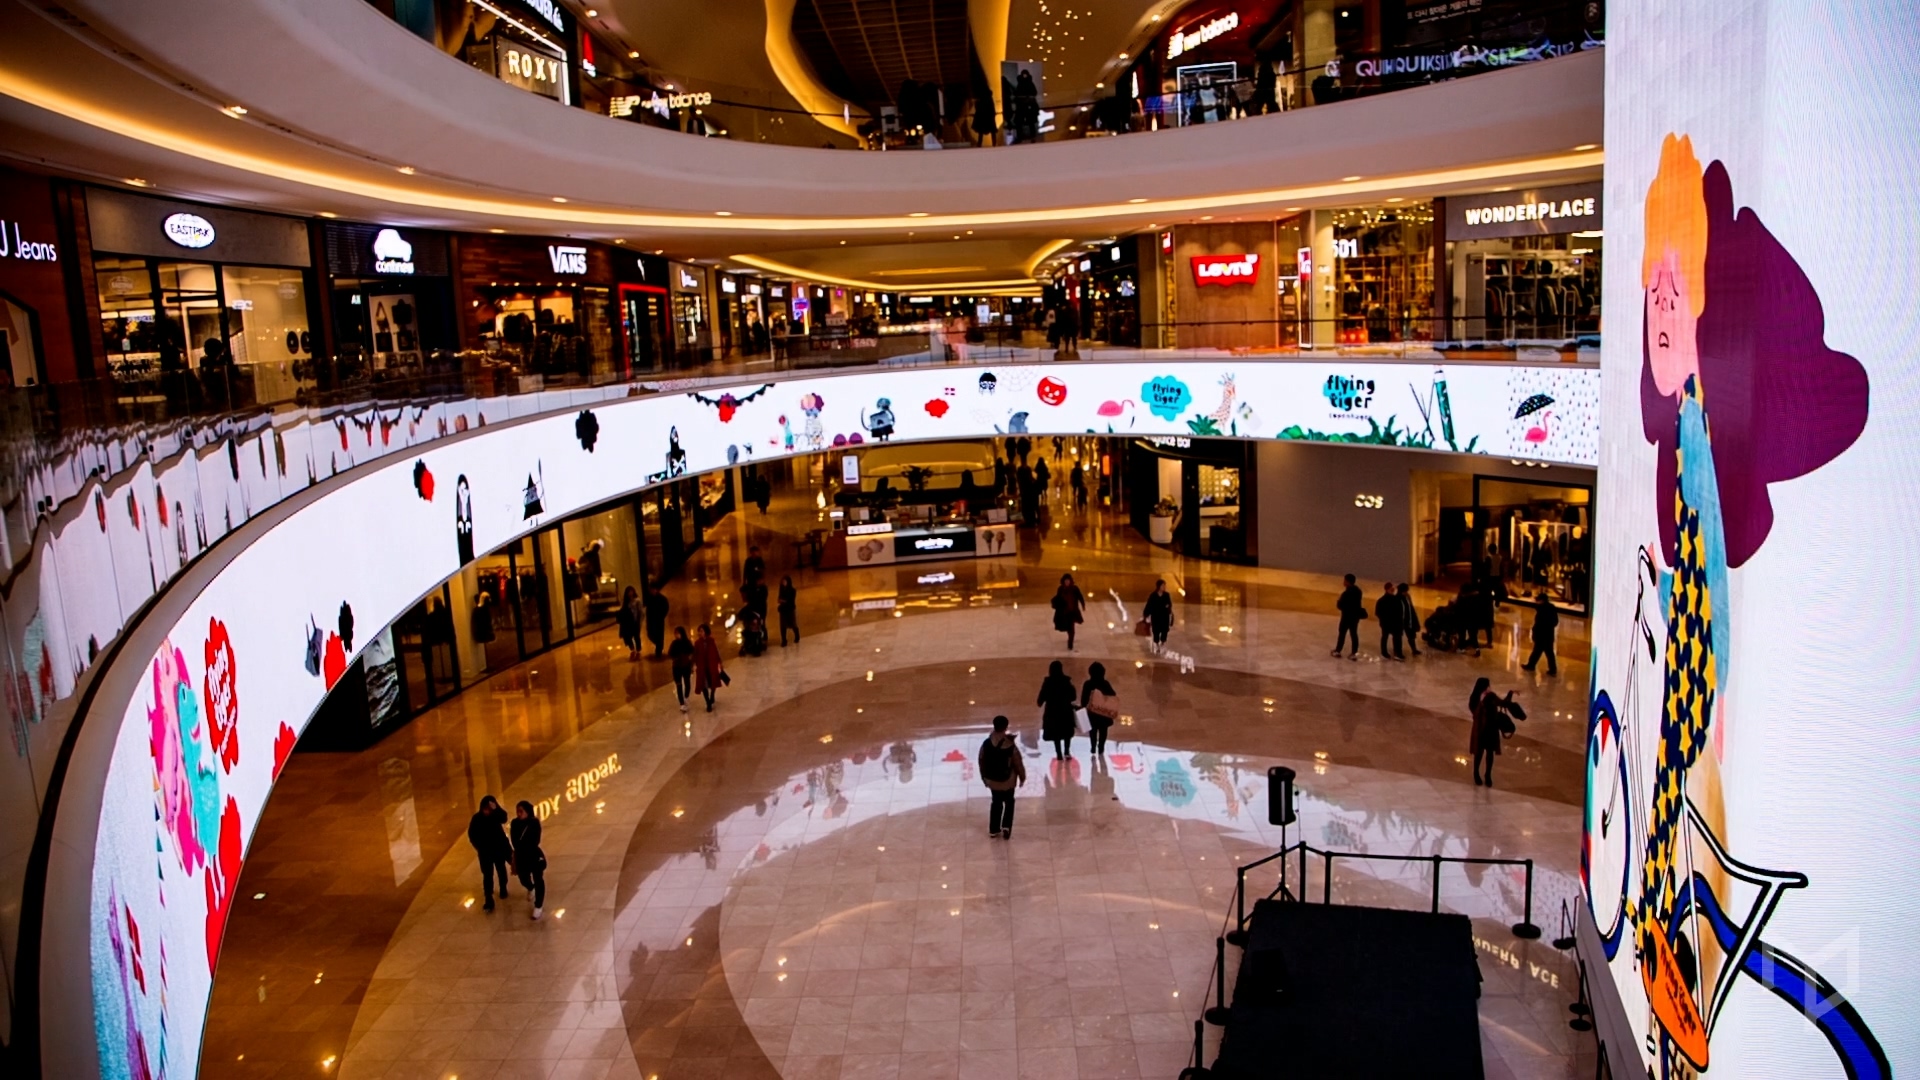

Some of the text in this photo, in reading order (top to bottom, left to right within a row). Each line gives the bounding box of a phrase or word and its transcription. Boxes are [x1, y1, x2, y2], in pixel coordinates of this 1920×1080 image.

[508, 50, 558, 83] ROXY
[1465, 198, 1596, 226] WONDERPLACE
[14, 221, 57, 262] Jeans
[170, 222, 210, 238] EASTPAK
[548, 245, 588, 275] VANS
[1152, 383, 1182, 396] flying
[1327, 374, 1376, 395] flying
[1153, 393, 1180, 405] tiger
[1329, 391, 1373, 412] tiger
[207, 641, 230, 704] flying
[214, 672, 232, 732] tiger
